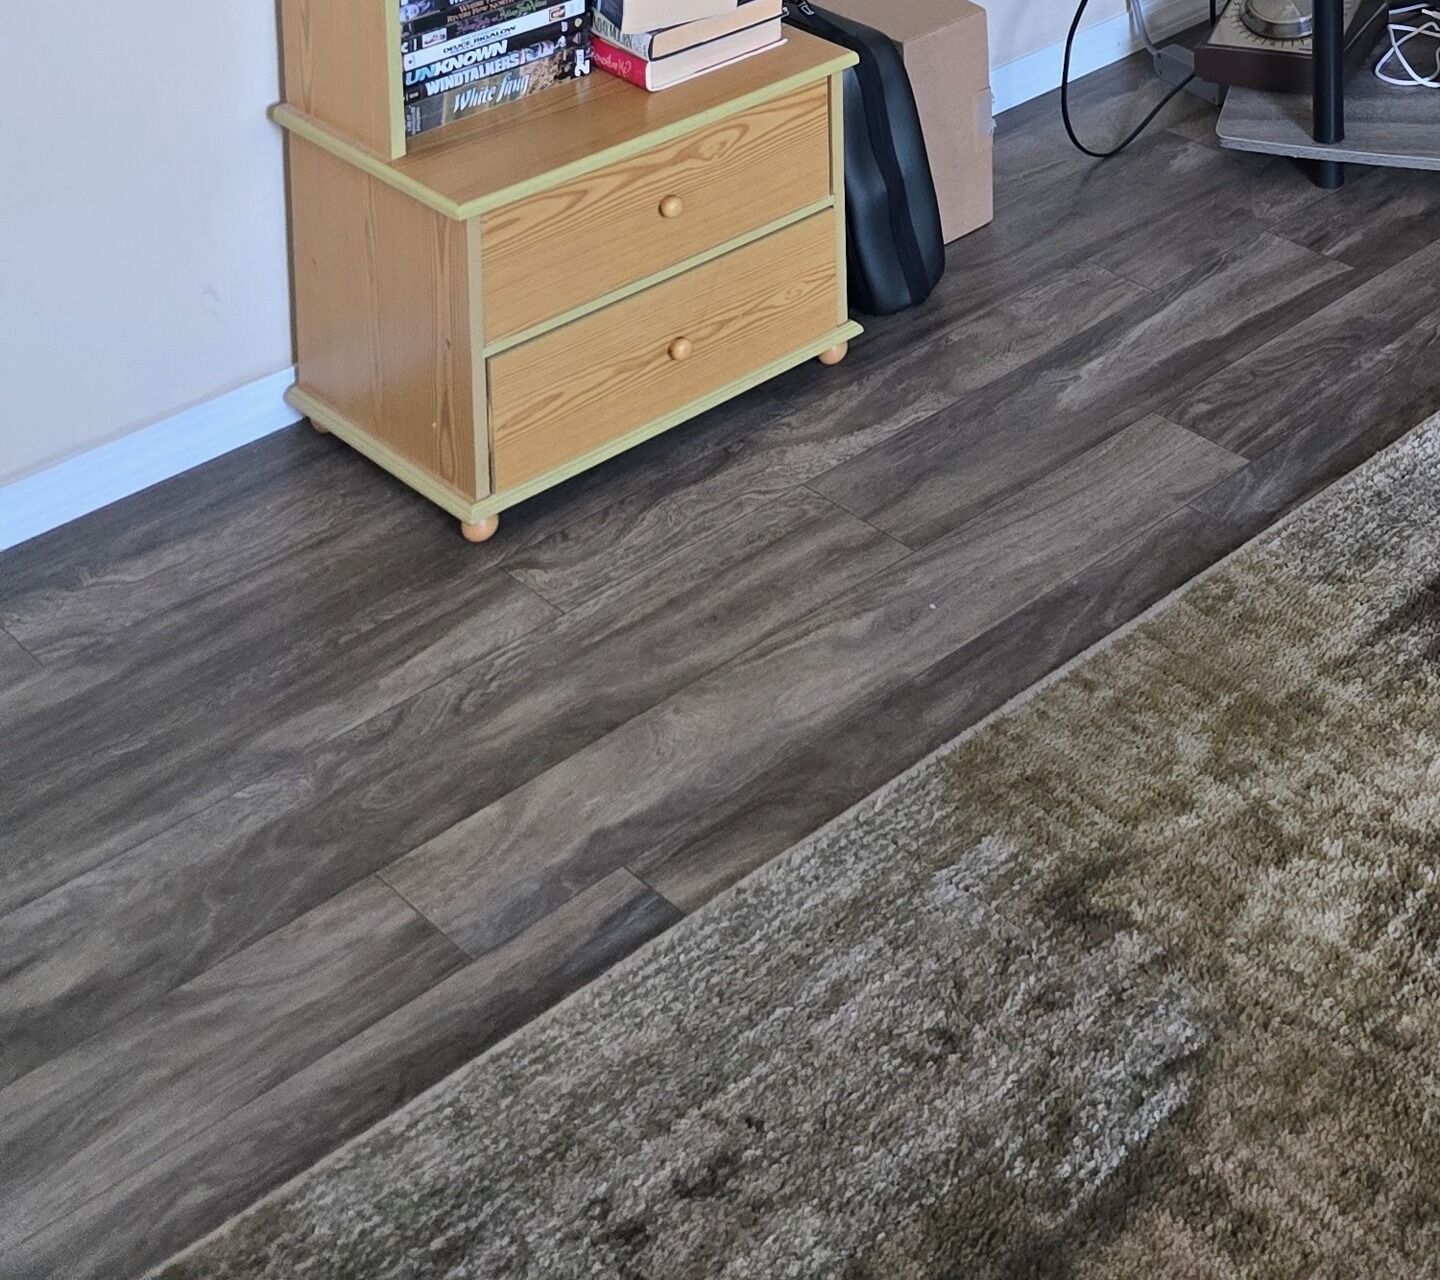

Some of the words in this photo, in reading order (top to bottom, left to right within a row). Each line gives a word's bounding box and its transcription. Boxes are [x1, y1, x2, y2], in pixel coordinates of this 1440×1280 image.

[442, 41, 472, 54] DEUCE
[472, 25, 517, 44] BIGALOW
[406, 39, 508, 86] UNKNOWN
[425, 51, 519, 97] WINDTALKERS
[453, 83, 498, 114] White
